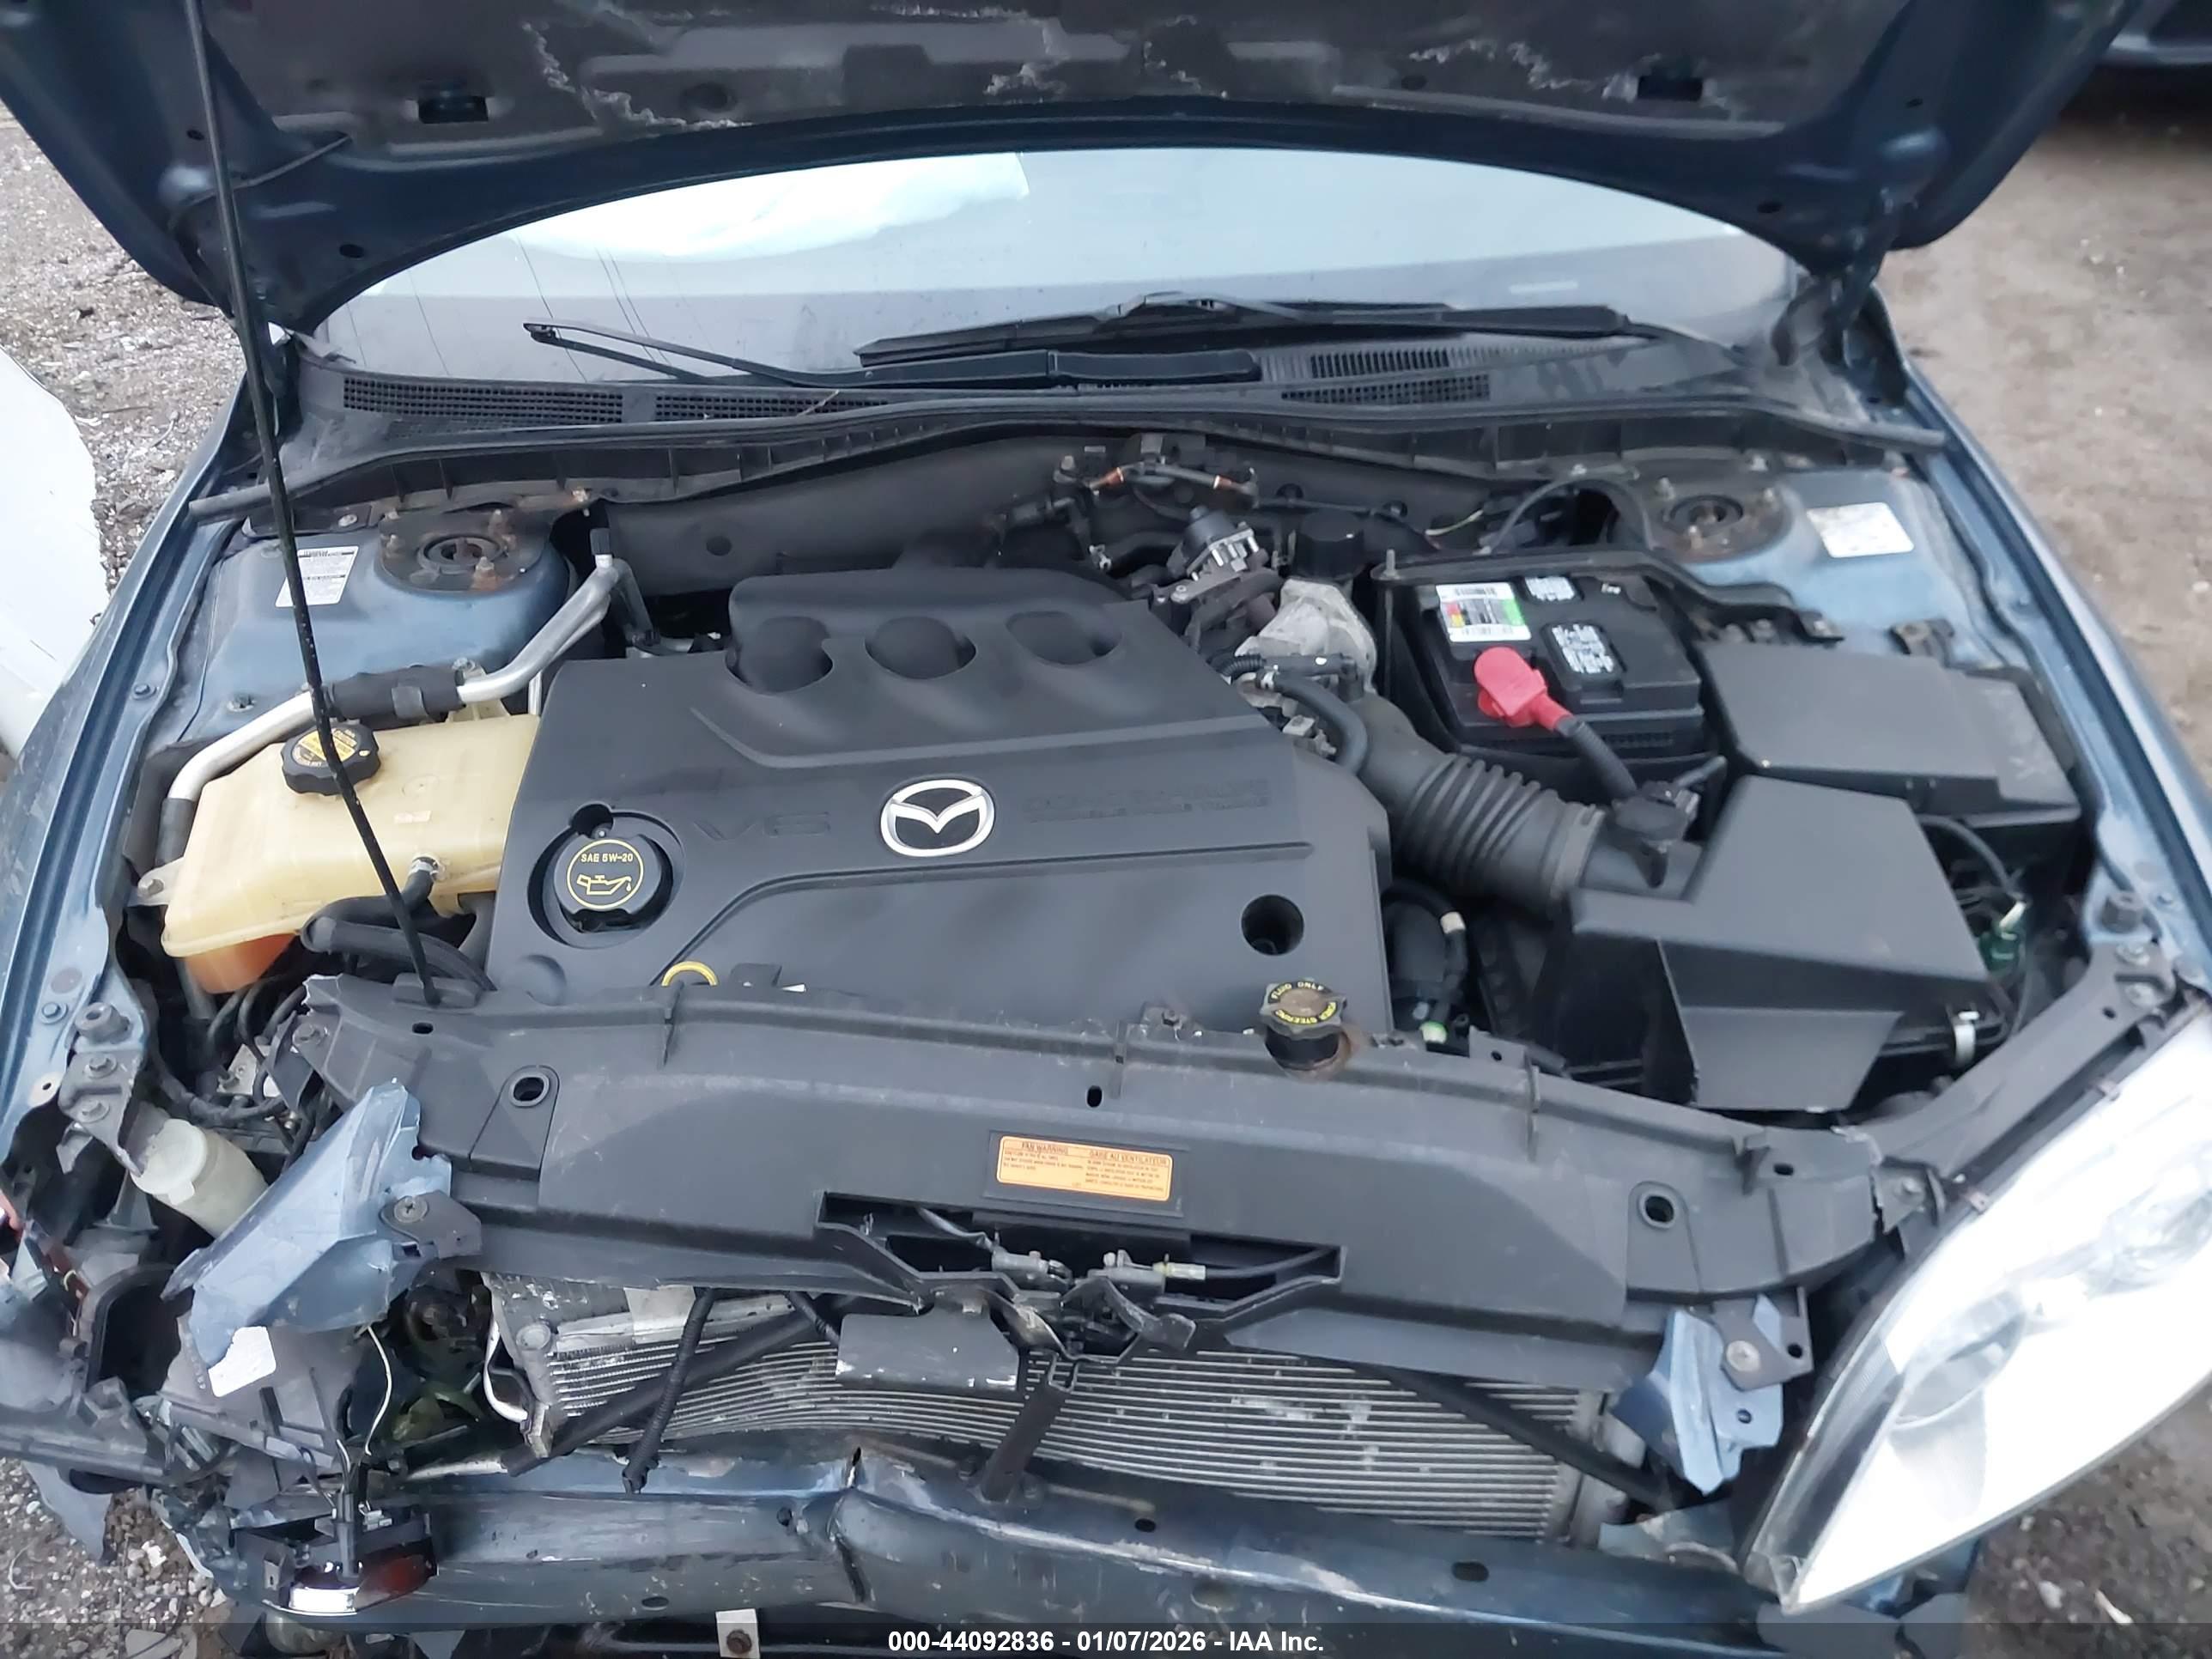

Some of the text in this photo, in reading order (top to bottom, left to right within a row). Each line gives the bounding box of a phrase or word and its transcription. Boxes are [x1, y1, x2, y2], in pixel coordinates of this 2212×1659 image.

[580, 853, 634, 863] SAE 5W-20
[1271, 982, 1292, 1000] FLUID
[1036, 1143, 1068, 1155] WARNING
